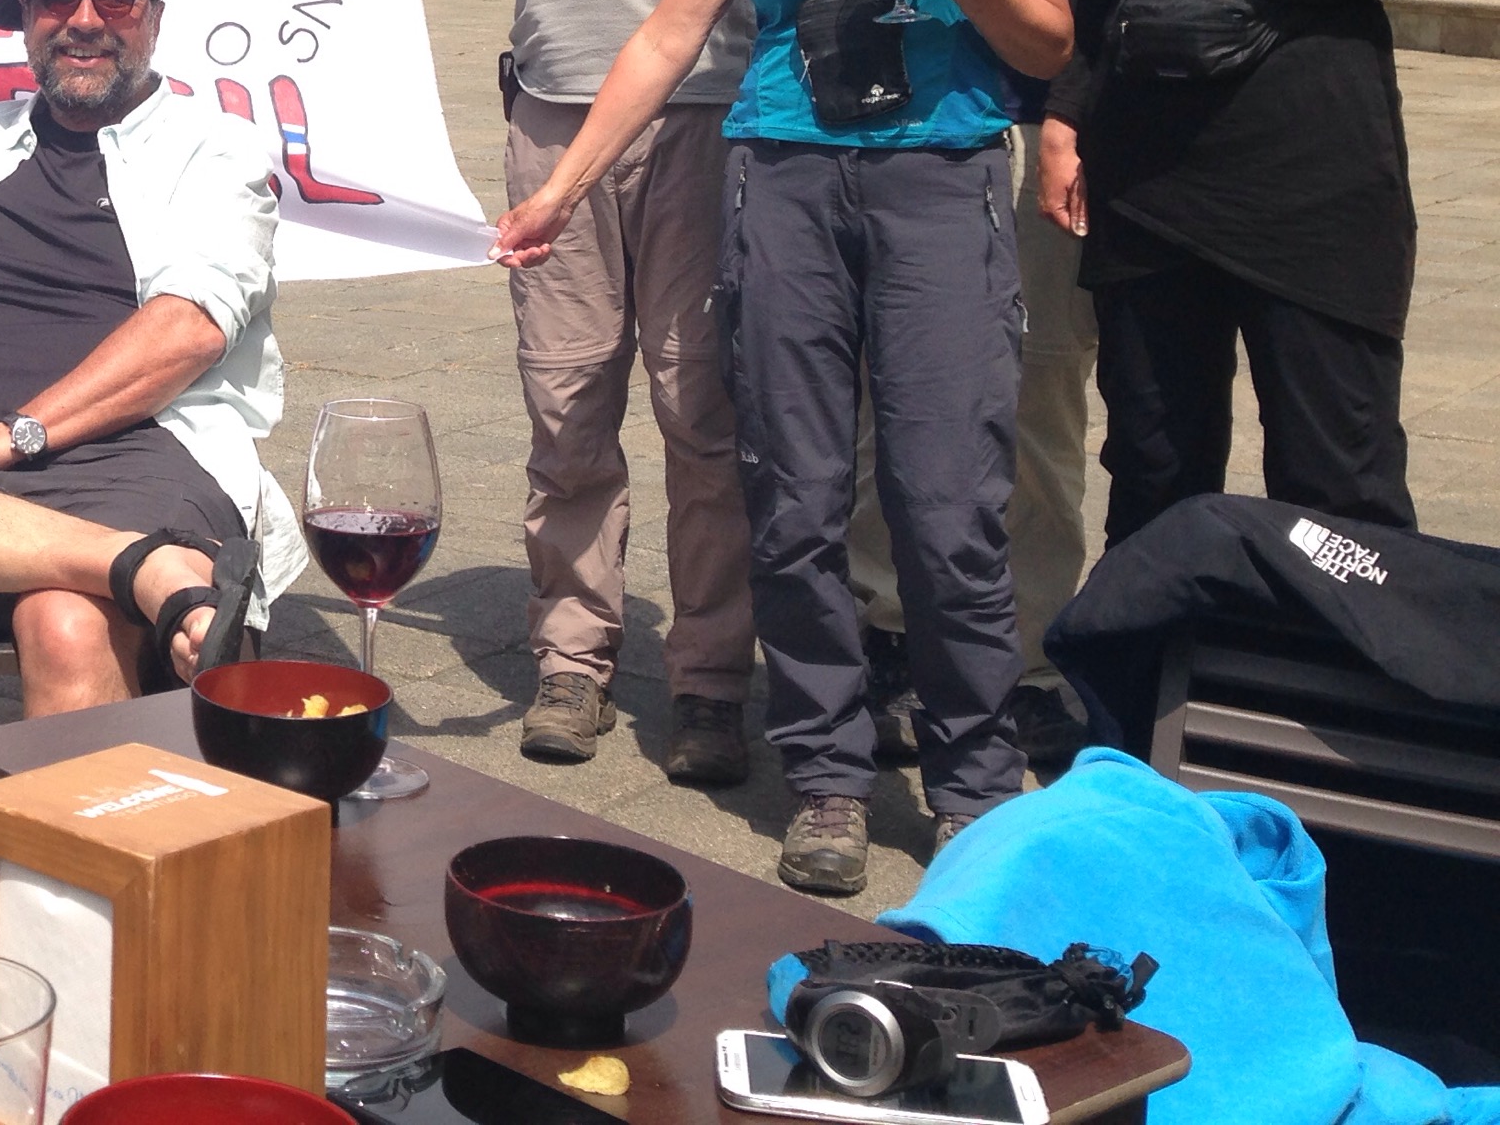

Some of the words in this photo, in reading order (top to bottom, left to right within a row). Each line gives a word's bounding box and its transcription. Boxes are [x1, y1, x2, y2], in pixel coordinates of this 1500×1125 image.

[1318, 544, 1389, 586] NORTH
[1324, 532, 1381, 565] FACE
[1311, 555, 1350, 584] THE
